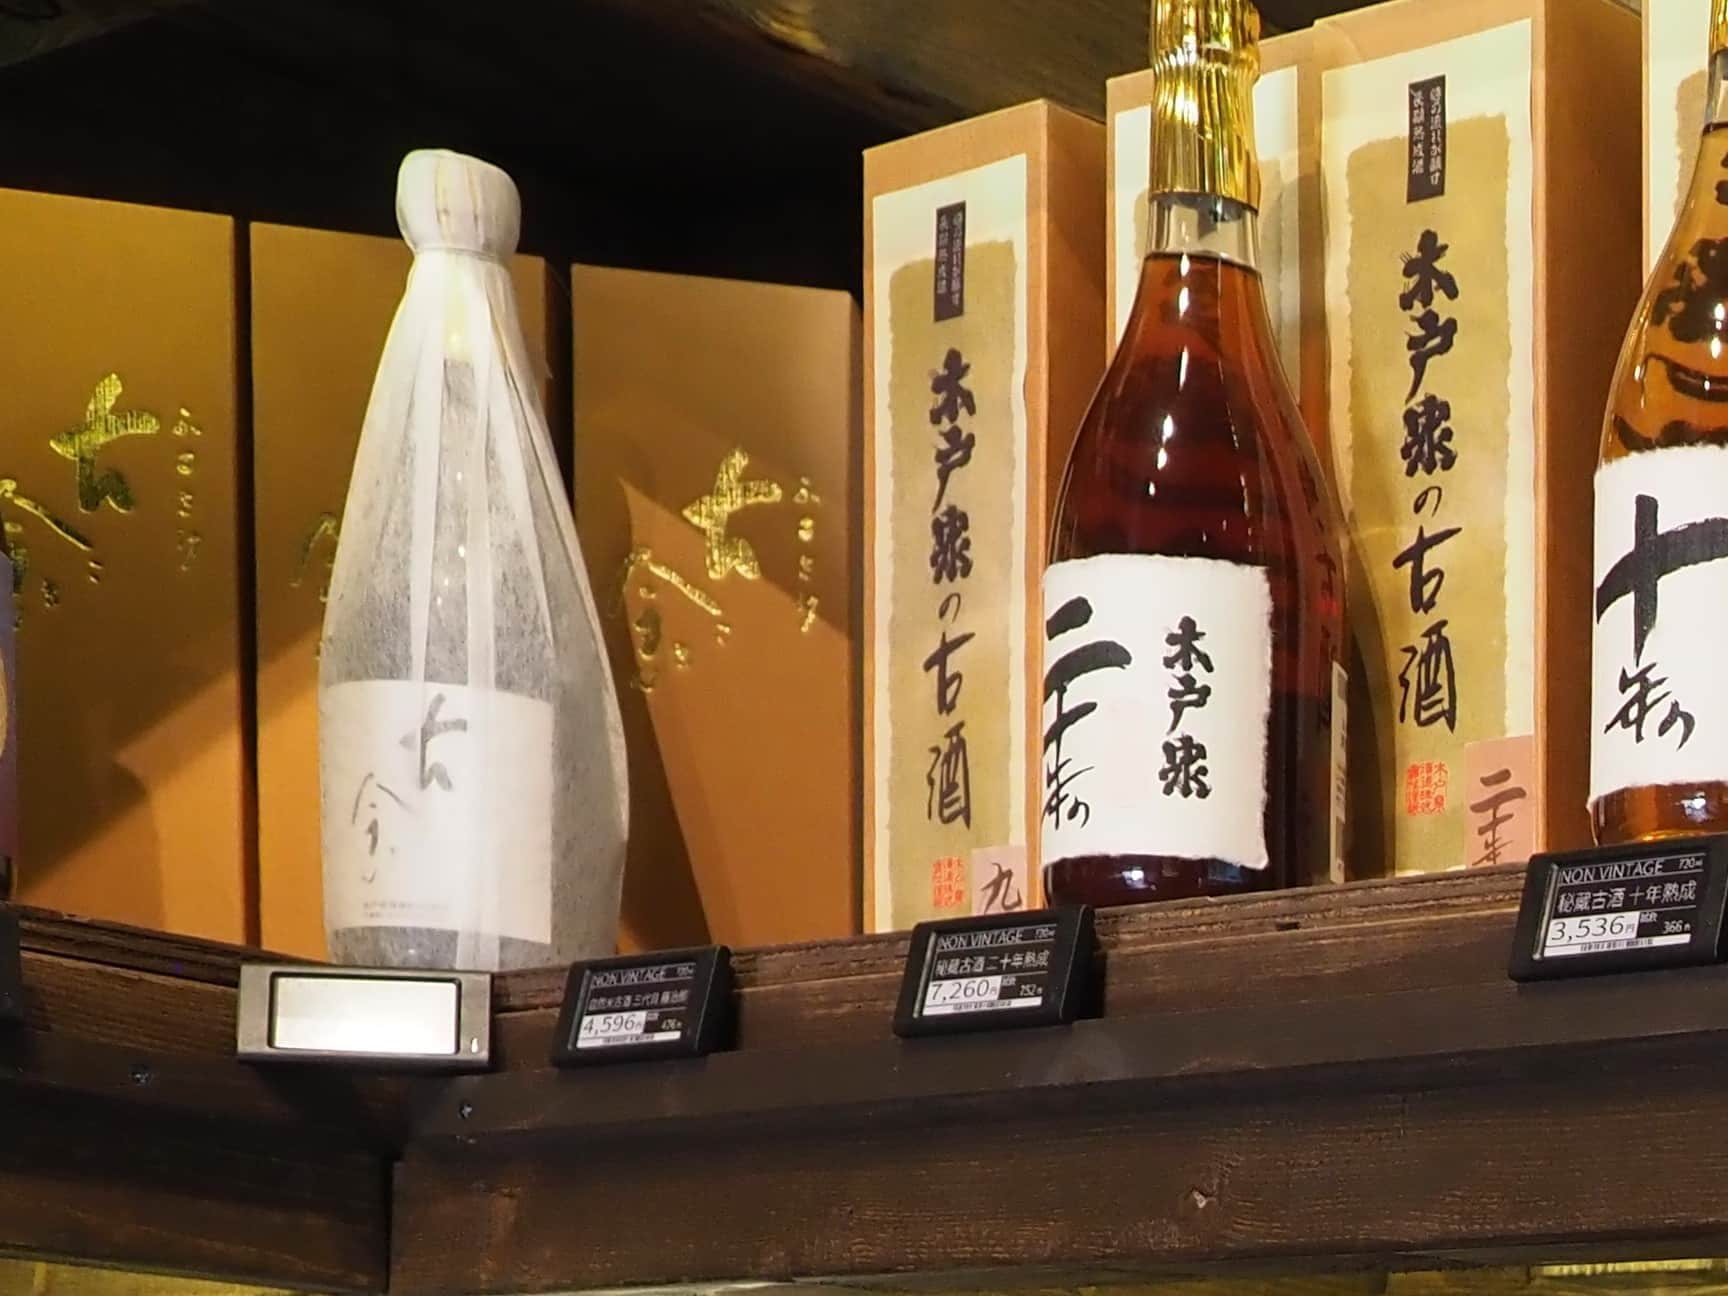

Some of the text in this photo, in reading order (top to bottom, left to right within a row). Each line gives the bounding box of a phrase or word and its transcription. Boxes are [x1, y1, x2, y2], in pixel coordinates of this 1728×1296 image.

[1393, 229, 1462, 734] 木戸泉の古酒
[922, 347, 977, 830] 木戸泉の古酒
[1158, 615, 1214, 799] 木戸泉
[1557, 879, 1697, 913] 秘蔵古酒 十年熟成
[1559, 859, 1664, 885] NON VINTAGE
[1551, 914, 1635, 942] 3,536円
